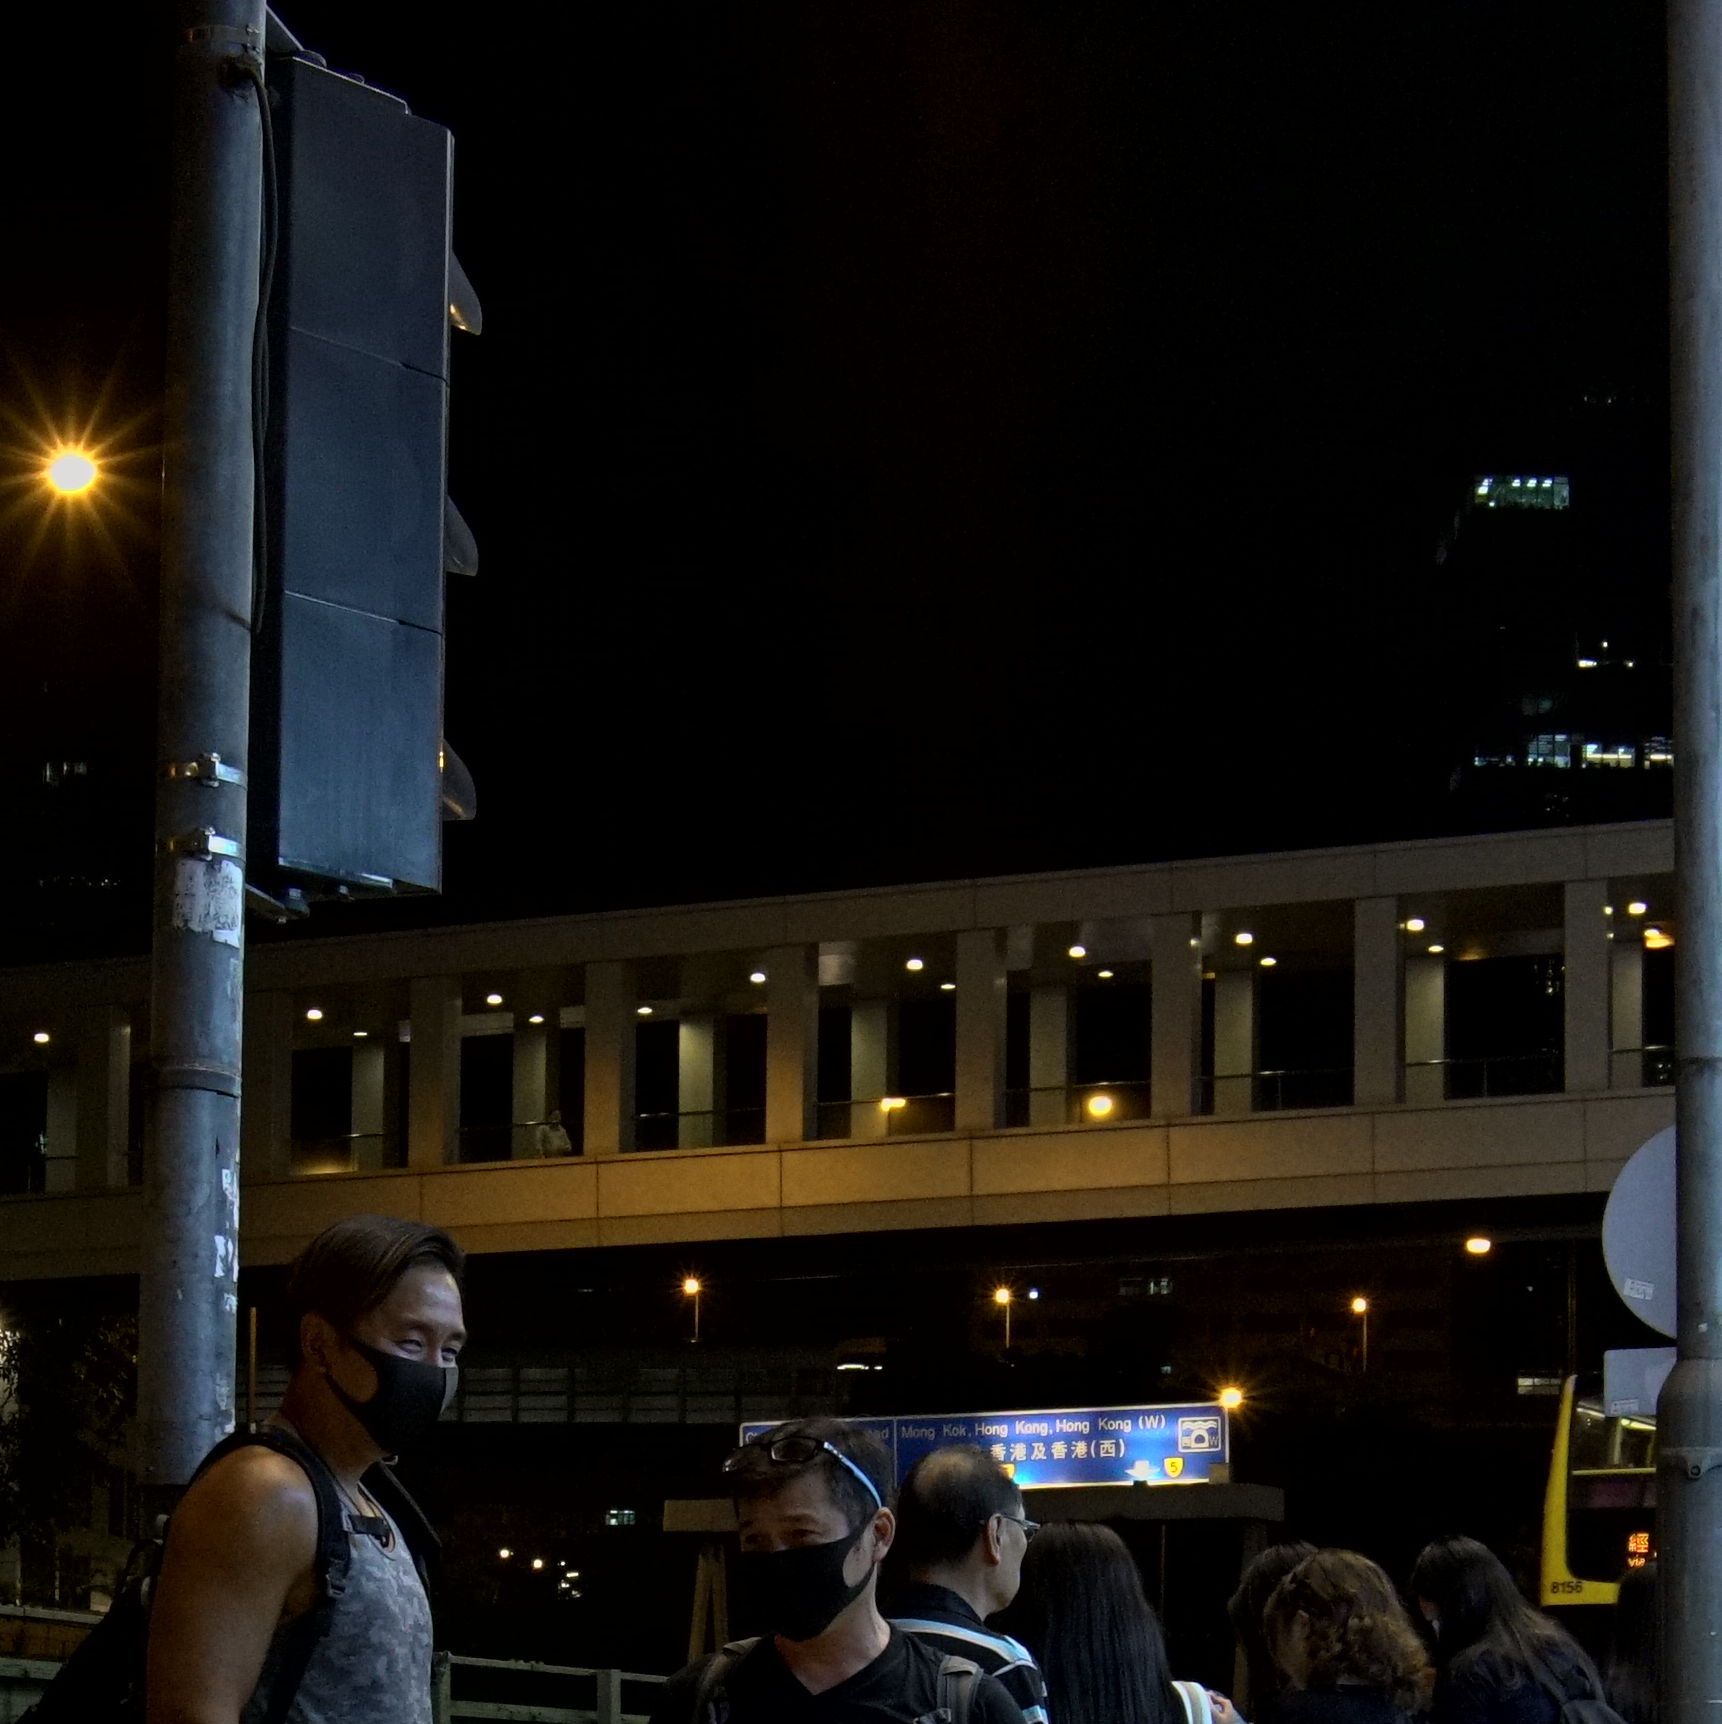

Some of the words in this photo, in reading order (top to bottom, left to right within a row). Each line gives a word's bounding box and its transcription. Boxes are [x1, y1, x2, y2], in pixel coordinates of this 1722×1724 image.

[901, 1426, 936, 1440] Mong
[975, 1421, 1009, 1437] Hong
[1056, 1419, 1090, 1434] Hong
[1098, 1418, 1132, 1433] Kong
[1138, 1414, 1166, 1430] (W)
[1170, 1461, 1178, 1474] 5
[1551, 1581, 1583, 1594] 8156
